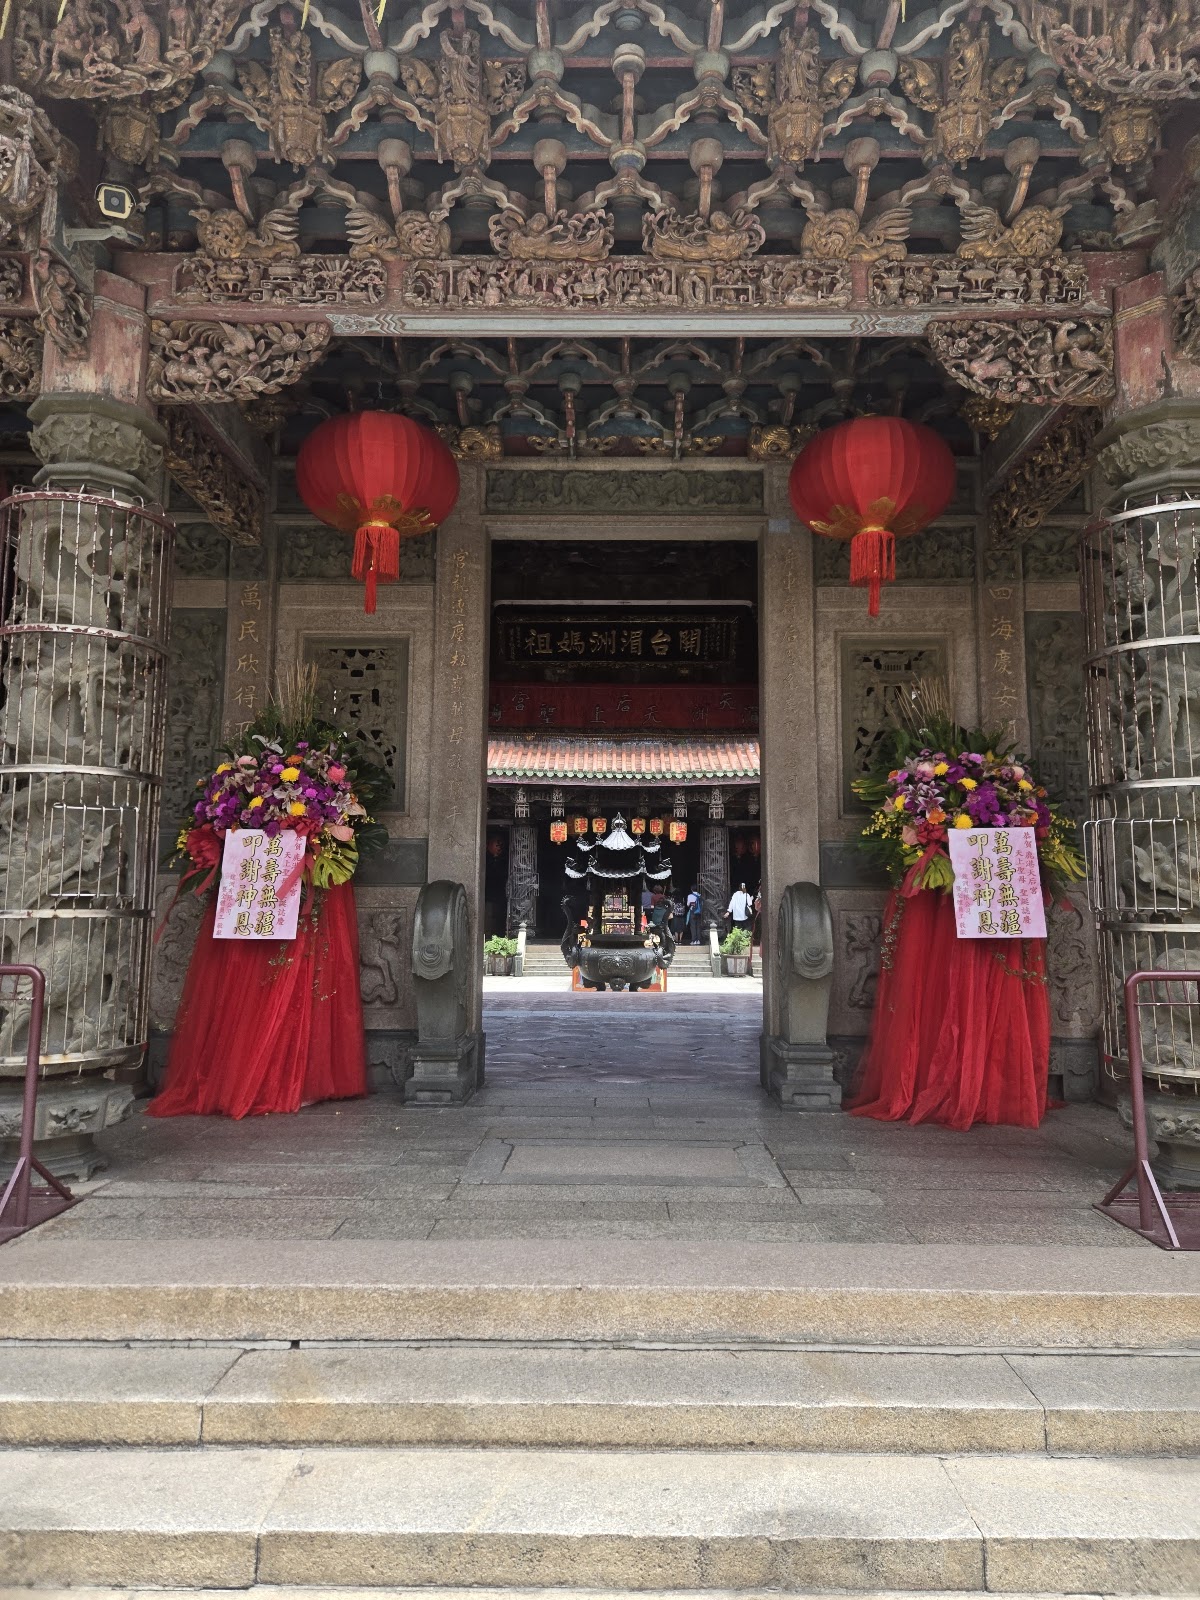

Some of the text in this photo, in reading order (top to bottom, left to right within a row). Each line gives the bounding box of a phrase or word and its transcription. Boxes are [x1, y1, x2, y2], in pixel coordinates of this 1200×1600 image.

[233, 835, 263, 936] 叩謝神恩
[254, 833, 283, 936] 萬壽無疆
[966, 833, 999, 935] 叩謝神恩
[992, 831, 1023, 935] 萬壽無疆
